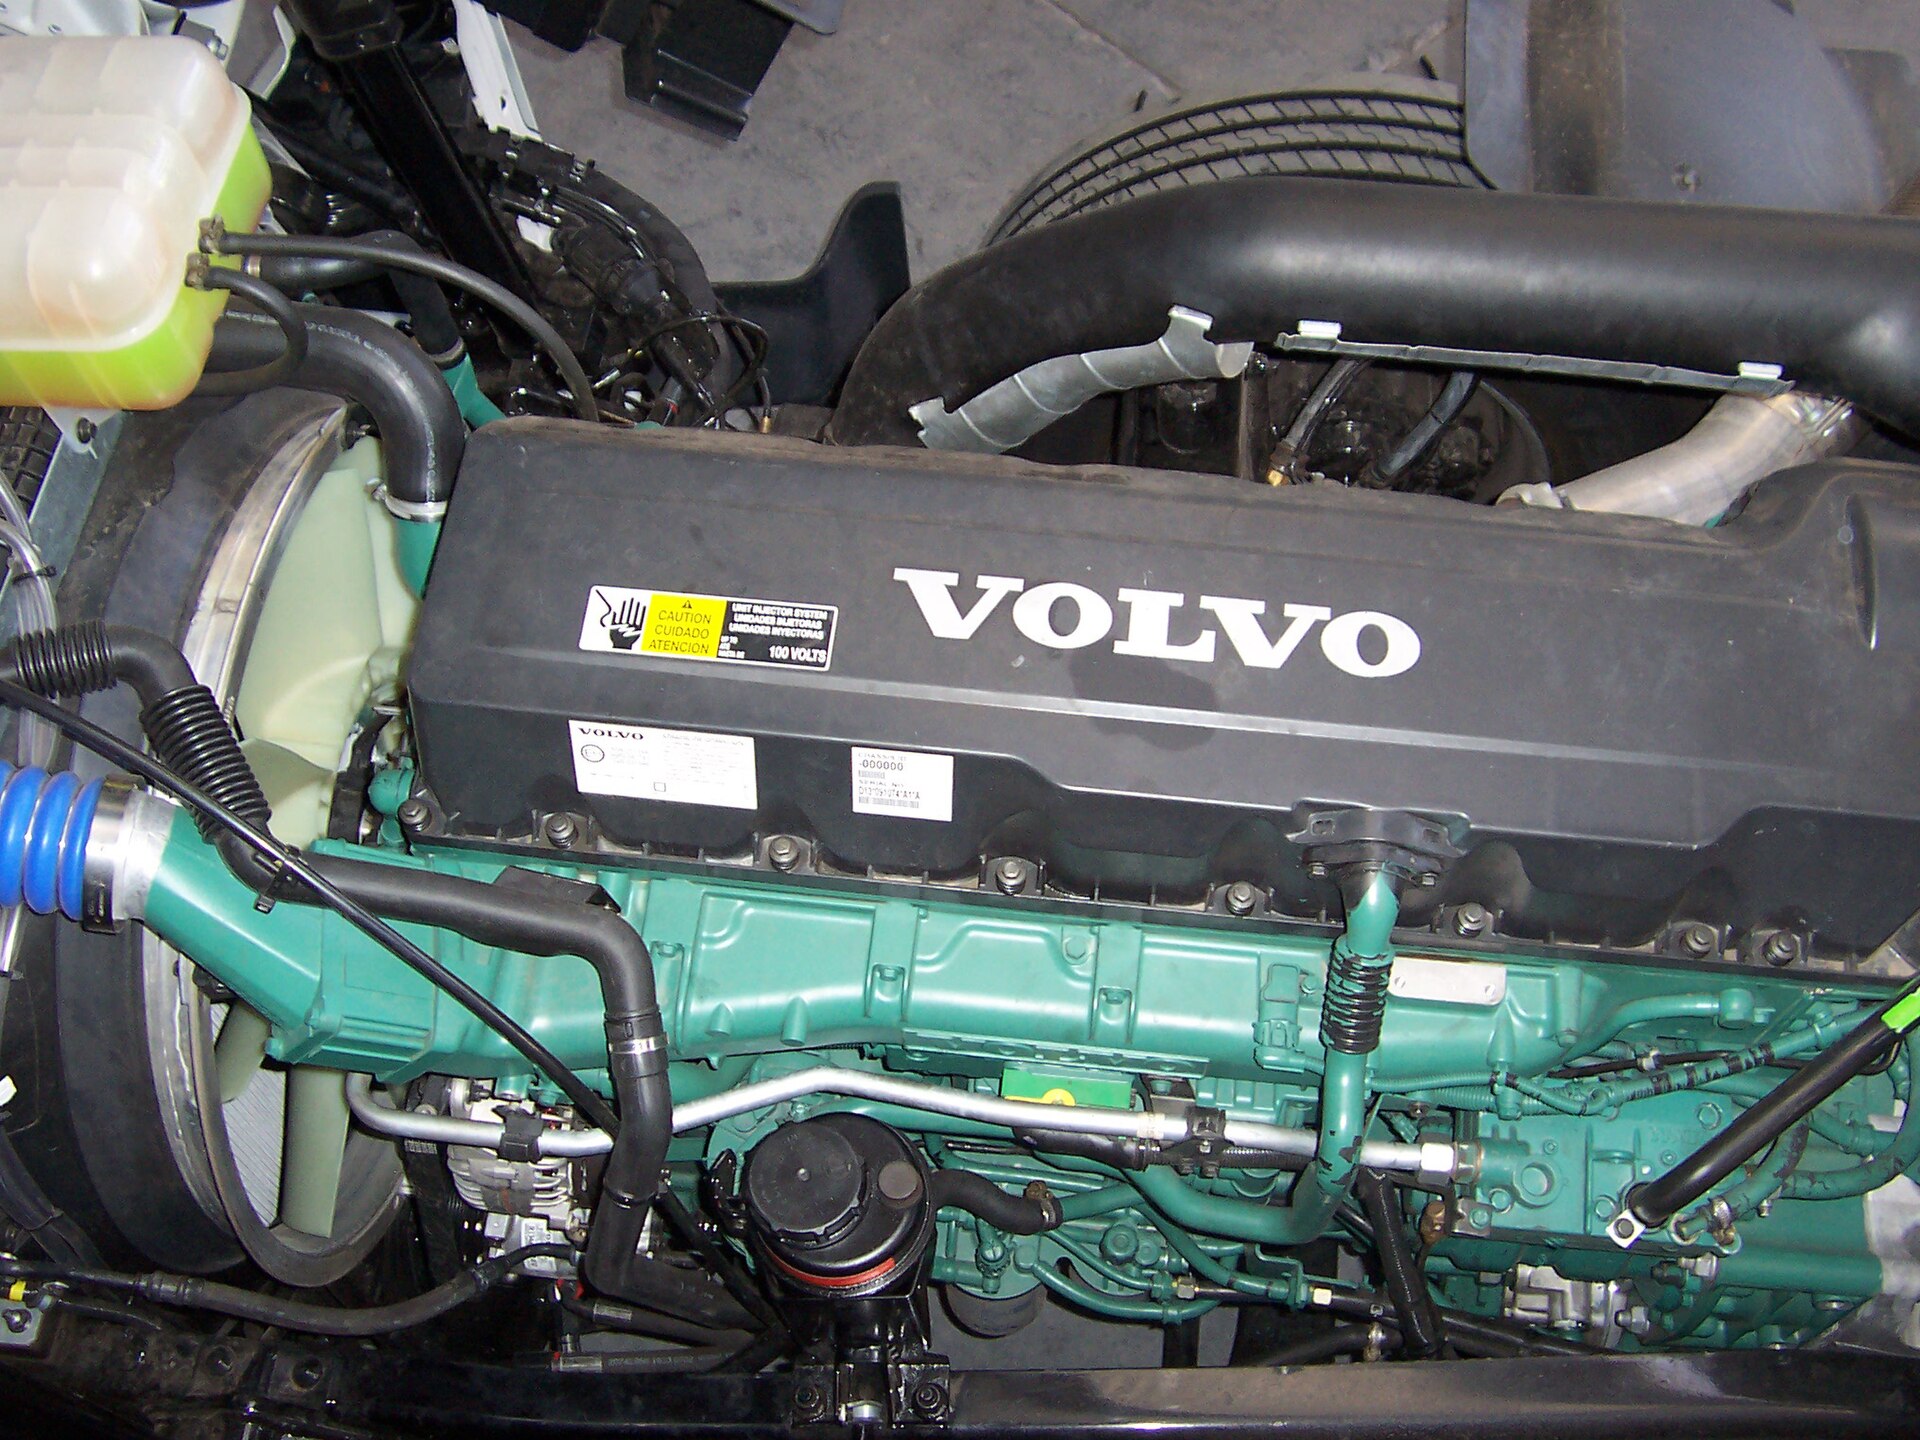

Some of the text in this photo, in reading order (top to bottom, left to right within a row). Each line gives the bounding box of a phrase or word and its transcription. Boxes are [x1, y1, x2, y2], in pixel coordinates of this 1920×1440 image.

[658, 610, 711, 624] CAUTION
[732, 603, 828, 620] UNIT INJECTOR SYSTEM
[734, 613, 776, 625] UNIDADES
[893, 567, 1421, 677] VOLVO
[655, 625, 709, 639] CUIDADO
[729, 622, 824, 640] UNIDADES INYECTORAS
[649, 639, 709, 654] ATENCION
[769, 645, 827, 663] 100 VOLTS
[579, 727, 644, 740] VOLVO
